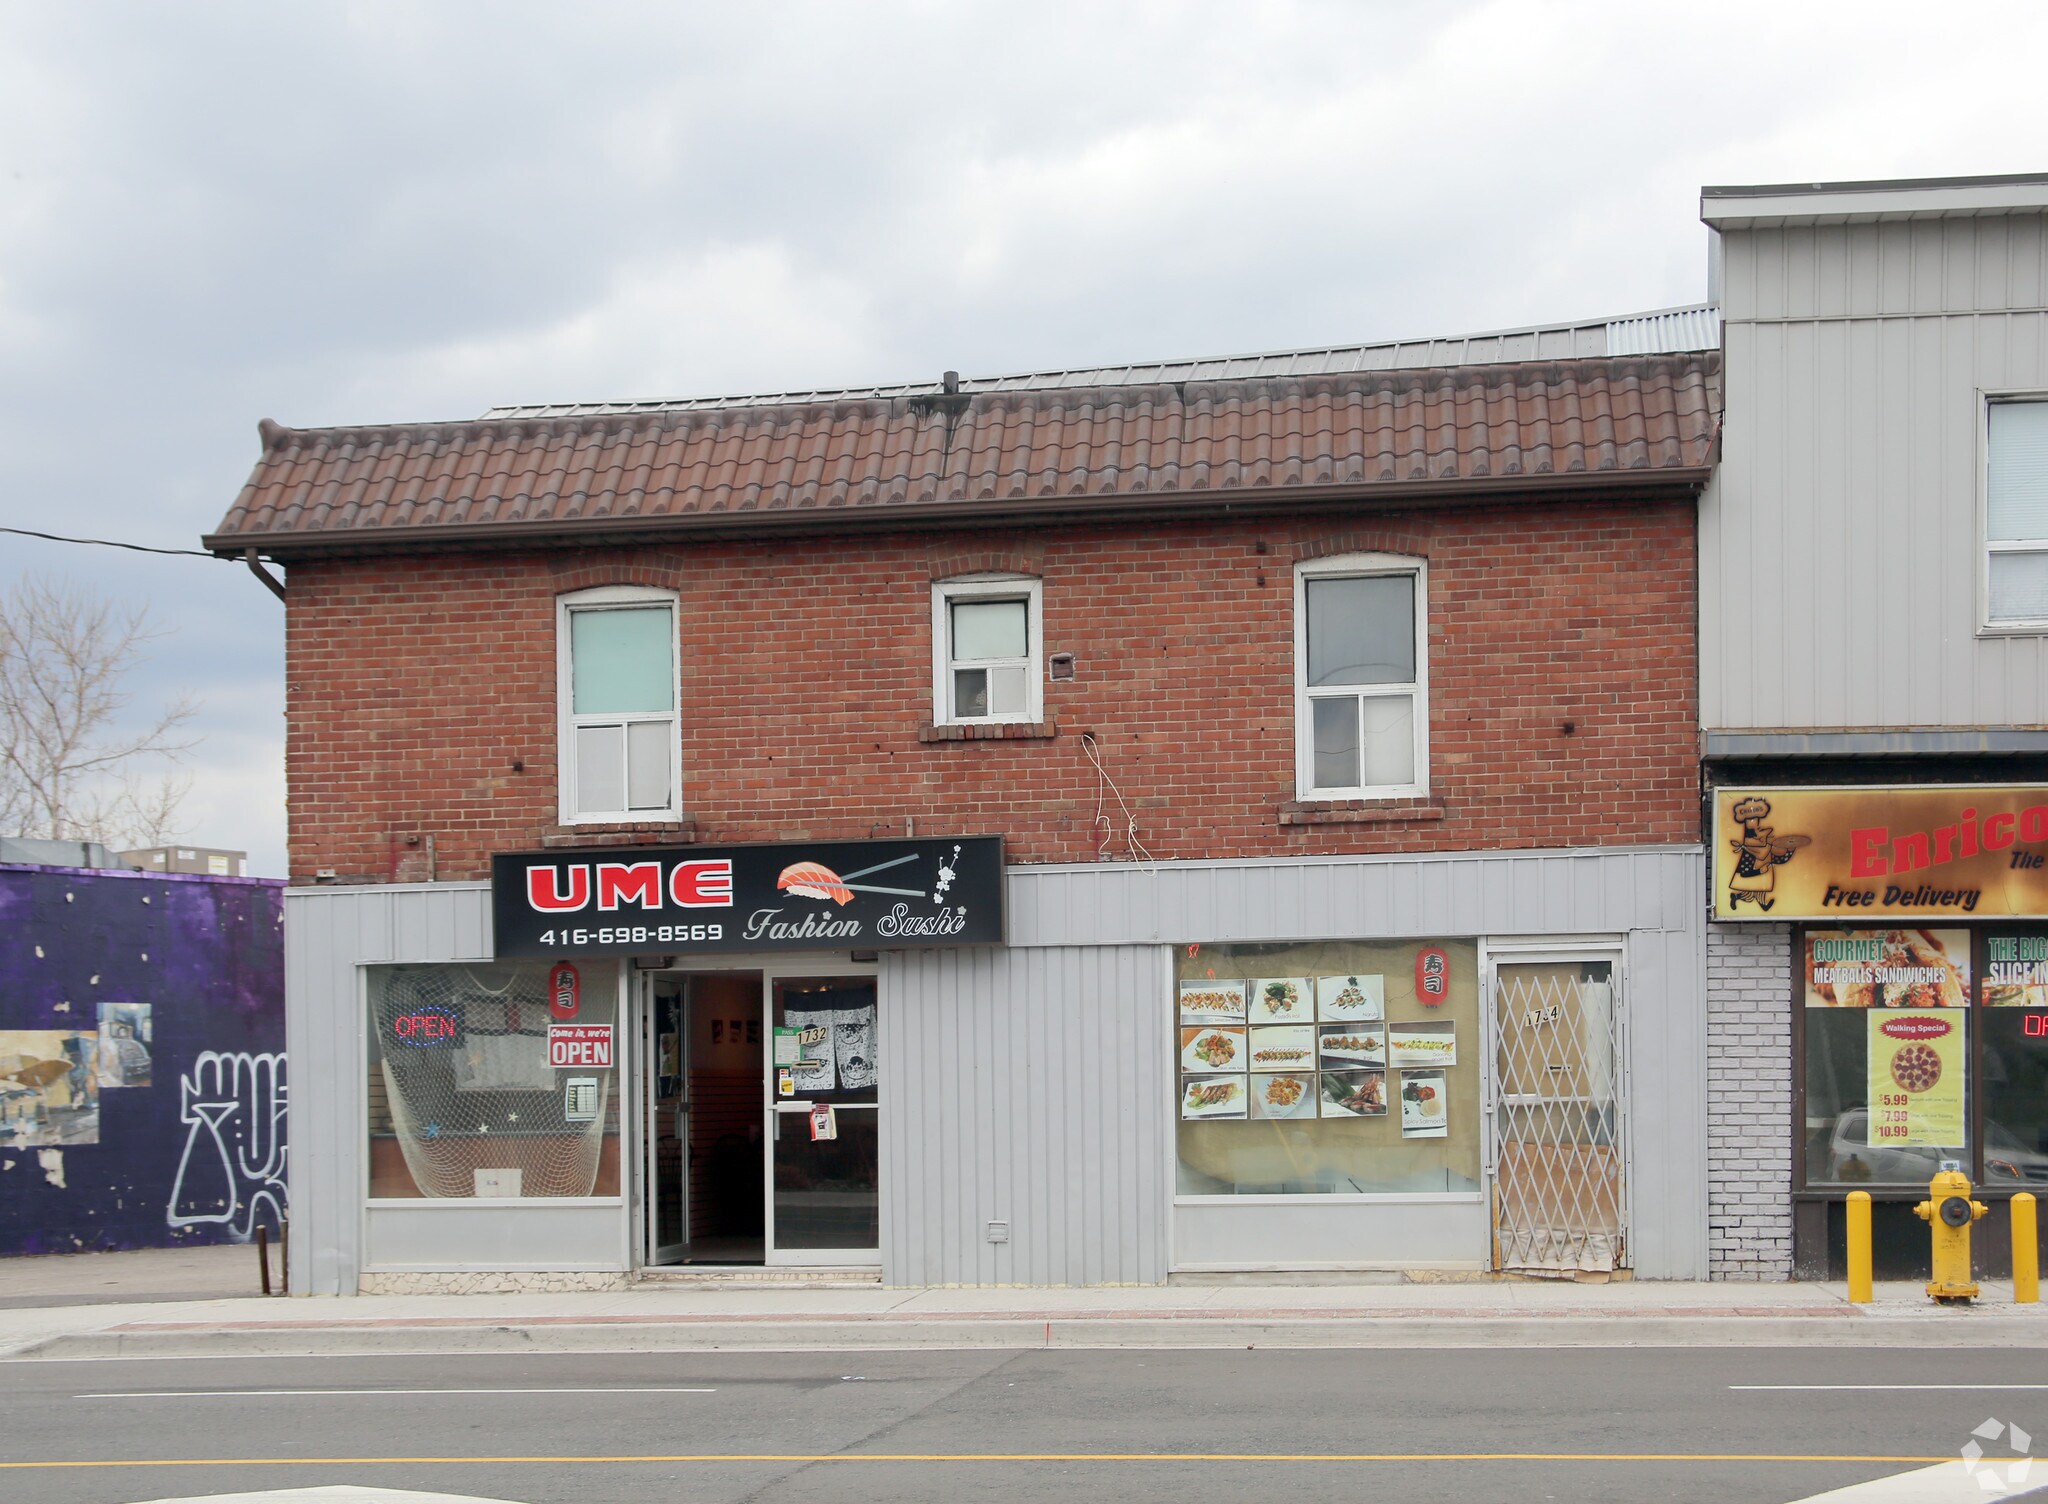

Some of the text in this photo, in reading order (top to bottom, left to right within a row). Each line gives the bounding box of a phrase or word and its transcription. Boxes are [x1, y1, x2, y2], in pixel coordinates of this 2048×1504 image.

[1850, 806, 2048, 878] Enrico
[2010, 851, 2045, 869] The
[526, 859, 733, 912] UME
[1822, 885, 1980, 911] Free Delivery
[742, 903, 967, 942] Fashion Sushi
[539, 924, 723, 946] 416-698-8569
[1814, 938, 1885, 963] GOURMET
[1989, 937, 2048, 961] THE BIG
[1813, 966, 1947, 984] MEATBALLS SANDWICHES
[1990, 962, 2031, 985] SLICE
[395, 1016, 455, 1037] OPEN
[550, 1028, 611, 1039] Come in, we're
[797, 1027, 827, 1044] 1732
[1886, 1024, 1946, 1033] Walking Special
[552, 1041, 609, 1064] OPEN
[1879, 1094, 1908, 1106] $5.99
[1874, 1125, 1909, 1138] $10.99
